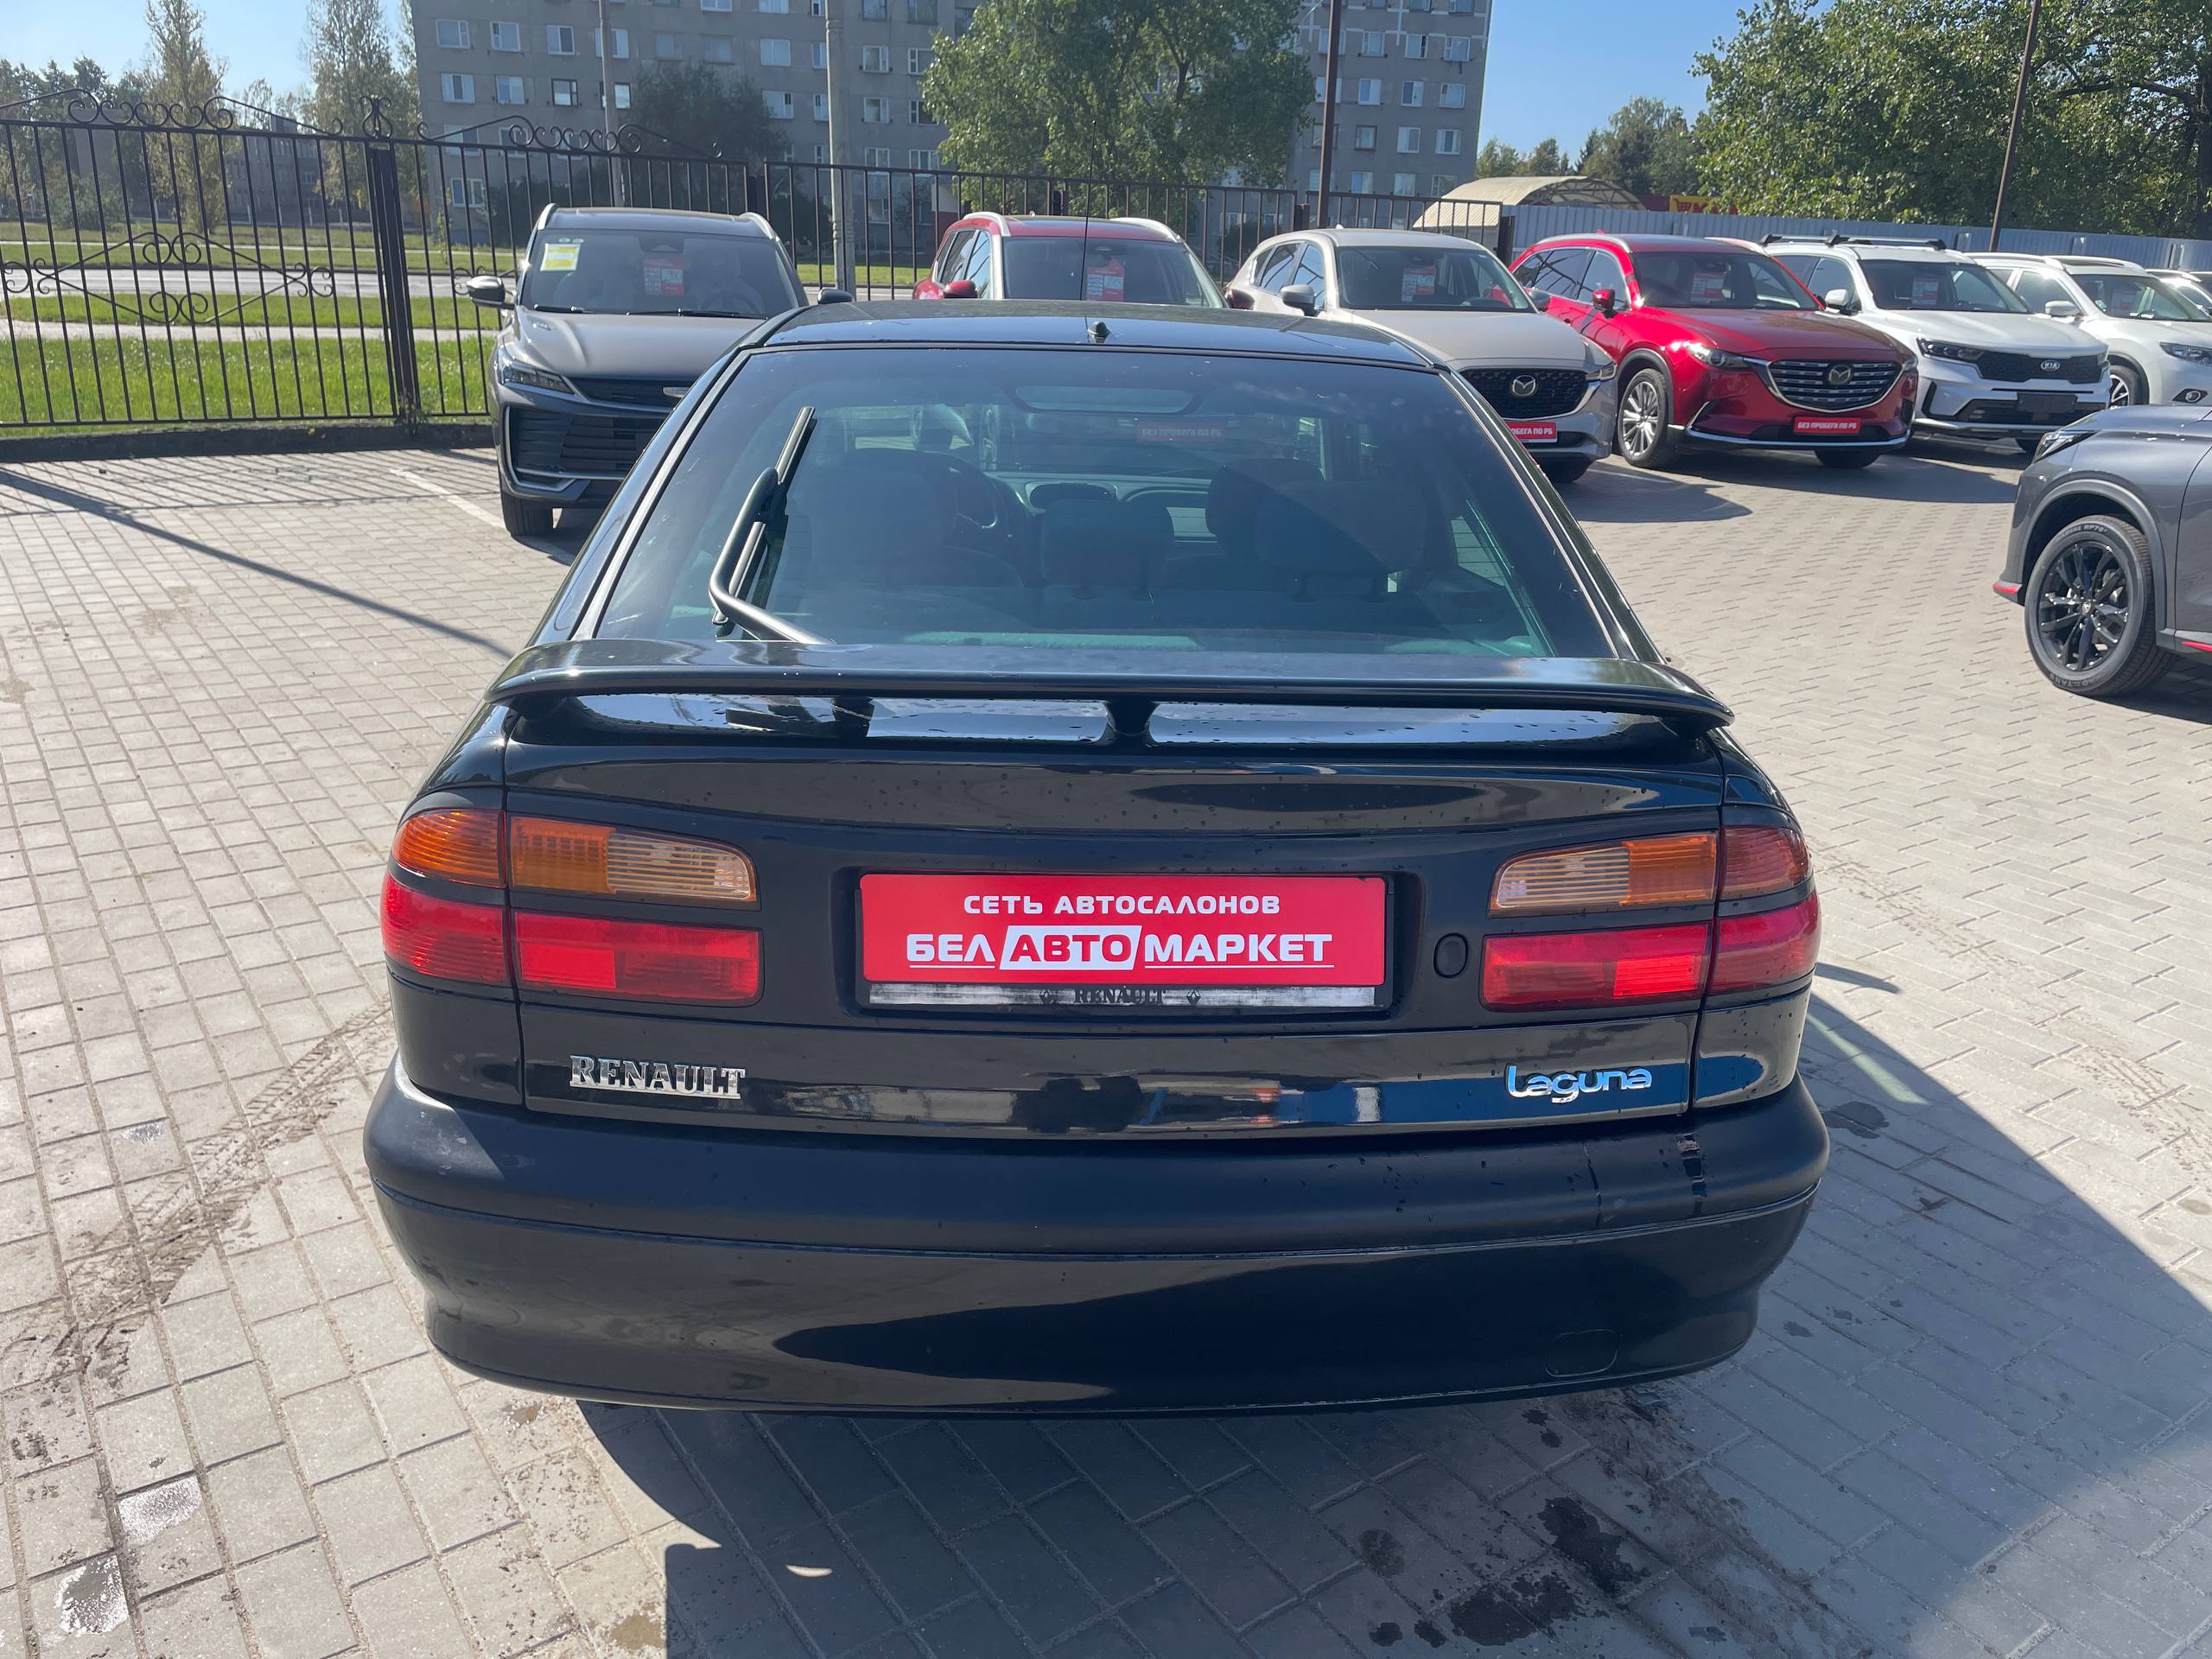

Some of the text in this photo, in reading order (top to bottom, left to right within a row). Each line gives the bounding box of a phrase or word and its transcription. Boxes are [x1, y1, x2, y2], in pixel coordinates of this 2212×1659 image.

[1510, 427, 1554, 435] ОБЕГА ПО РБ
[963, 895, 1281, 915] СЕТЬ АВТОСАЛОНОВ
[1073, 987, 1166, 1006] RENAULT
[569, 1055, 746, 1099] RENAULT
[1507, 1065, 1653, 1103] Laguna
